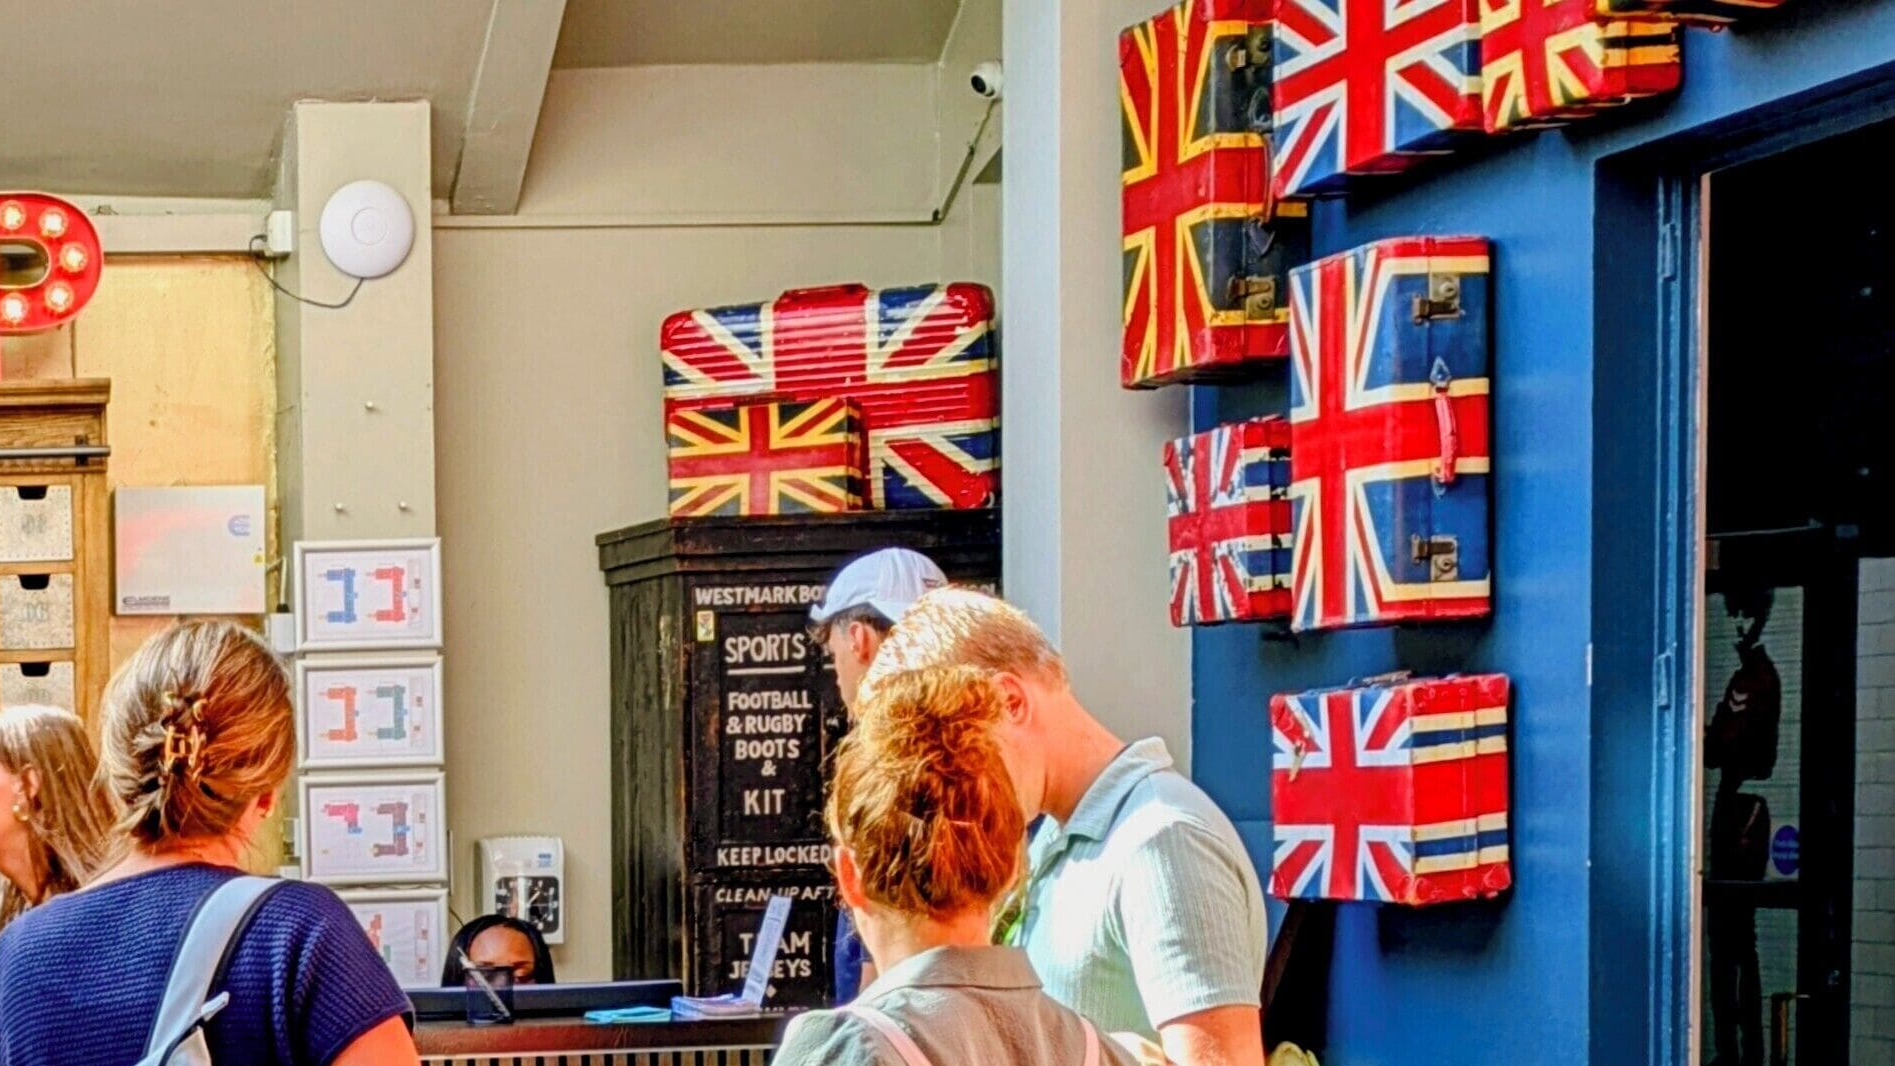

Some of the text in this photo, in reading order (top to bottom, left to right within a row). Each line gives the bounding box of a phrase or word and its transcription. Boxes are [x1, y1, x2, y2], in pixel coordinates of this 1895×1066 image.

[695, 585, 826, 605] WESTMARK BO
[724, 633, 805, 663] SPORTS
[727, 690, 813, 711] FOOTBALL
[725, 713, 806, 735] & RUGBY
[735, 738, 800, 760] BOOTS
[761, 760, 777, 777] &
[744, 788, 785, 816] KIT
[717, 844, 831, 866] KEEP LOCKED
[739, 931, 812, 955] TAM
[728, 958, 812, 979] JEEYS
